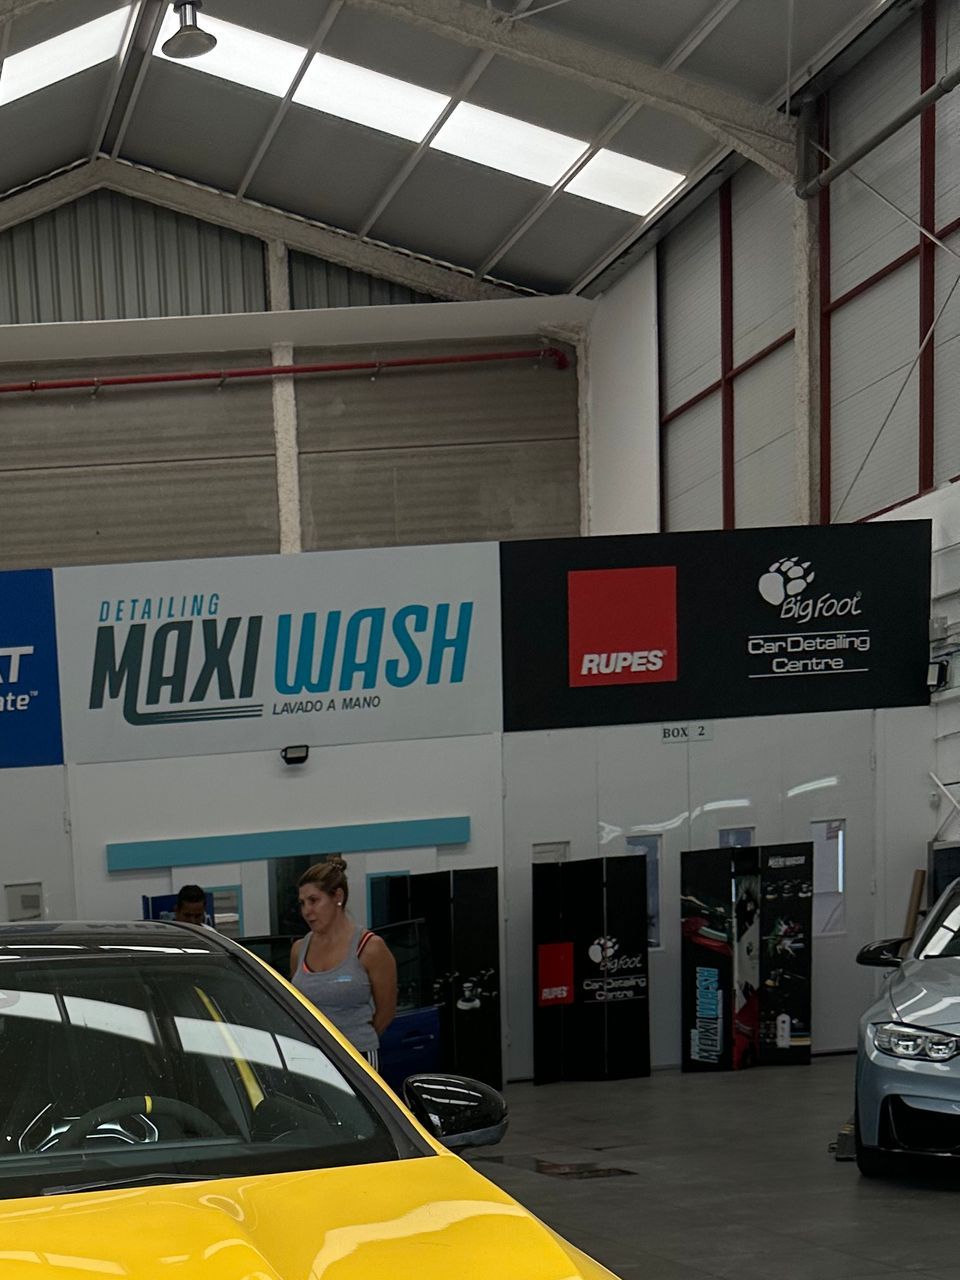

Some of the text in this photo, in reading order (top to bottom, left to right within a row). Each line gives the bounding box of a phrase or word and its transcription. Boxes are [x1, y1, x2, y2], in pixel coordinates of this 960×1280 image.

[99, 593, 219, 622] DETAILING
[88, 601, 474, 725] MAXI WASH
[581, 650, 663, 675] RUPES
[772, 656, 844, 673] Centre
[272, 695, 381, 715] LAVADO A MANO
[662, 726, 705, 739] BOX 2
[696, 967, 718, 1017] WASH
